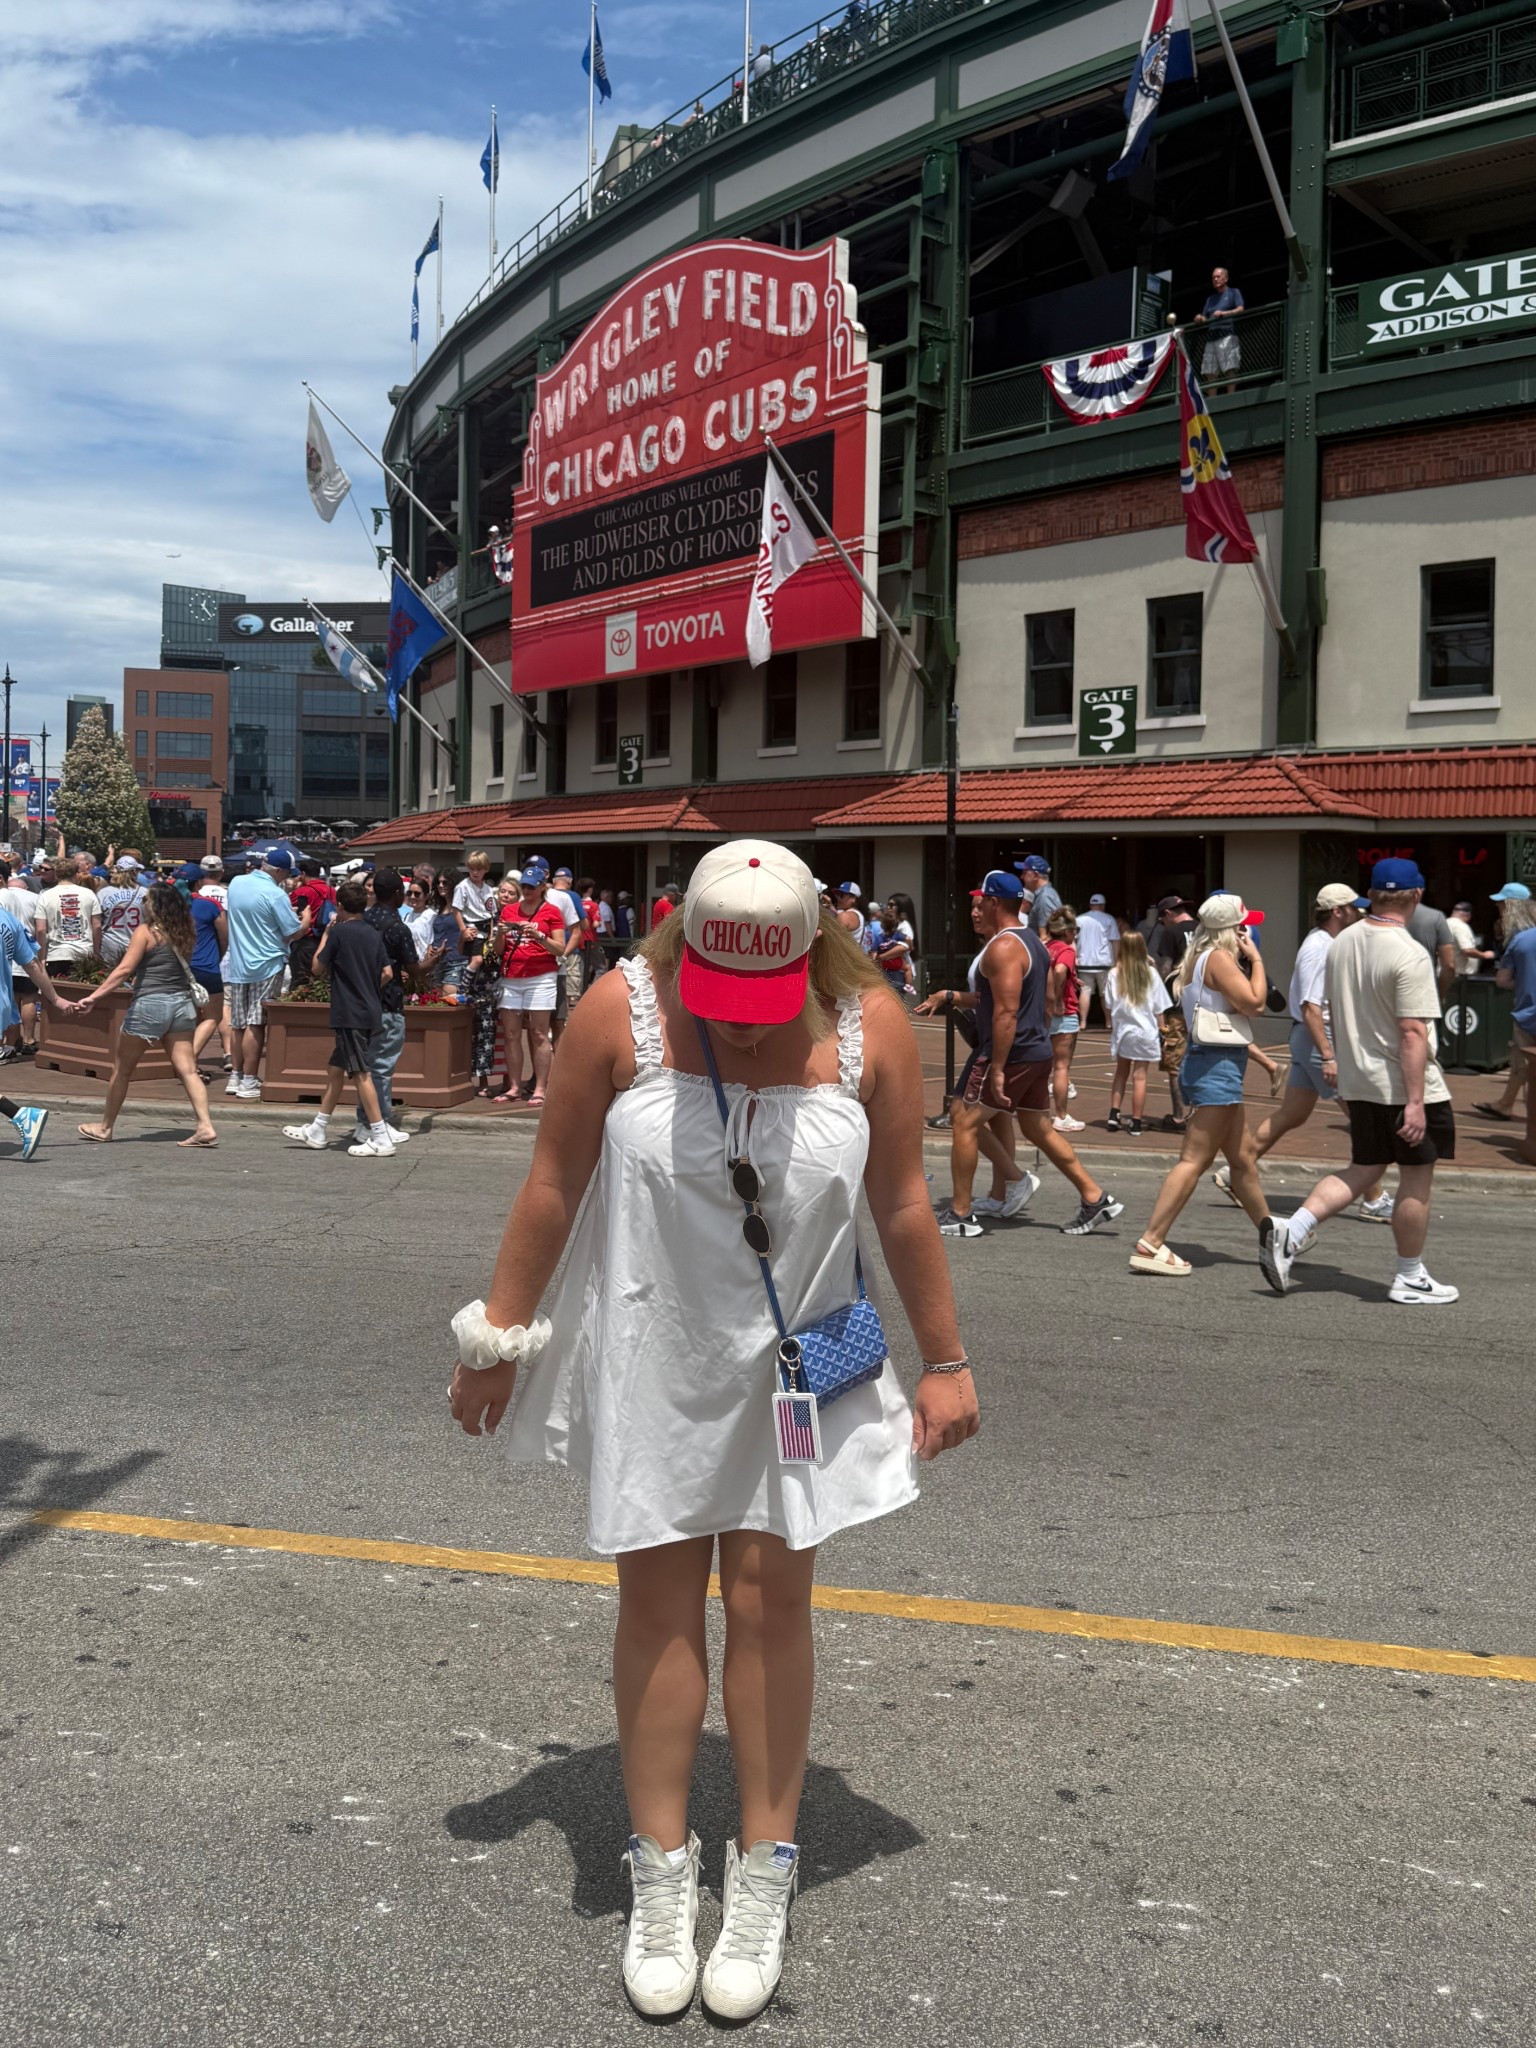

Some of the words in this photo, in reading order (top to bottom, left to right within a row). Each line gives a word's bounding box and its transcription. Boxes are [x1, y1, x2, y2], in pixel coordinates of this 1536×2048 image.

[1379, 254, 1536, 313] GATE
[1379, 300, 1509, 339] ADDISON
[543, 276, 687, 438] WRIGLEY
[702, 269, 818, 337] FIELD
[607, 361, 677, 415] HOME
[694, 338, 731, 378] OF
[541, 415, 687, 506] CHICAGO
[703, 366, 818, 451] CUBS
[593, 500, 644, 529] CHICAGO
[645, 489, 676, 513] CUBS
[679, 469, 742, 502] WELCOME
[541, 543, 570, 572] THE
[574, 514, 671, 563] BUDWEISER
[674, 470, 819, 534] CLYDESDES
[573, 561, 608, 591] AND
[612, 545, 665, 581] FOLDS
[669, 537, 695, 567] OF
[643, 610, 725, 650] TOYOTA
[1083, 688, 1134, 704] GATE
[620, 736, 643, 748] GATE
[1089, 703, 1126, 741] 3
[622, 747, 639, 775] 3
[111, 907, 141, 929] 23
[702, 919, 792, 958] CHICAGO
